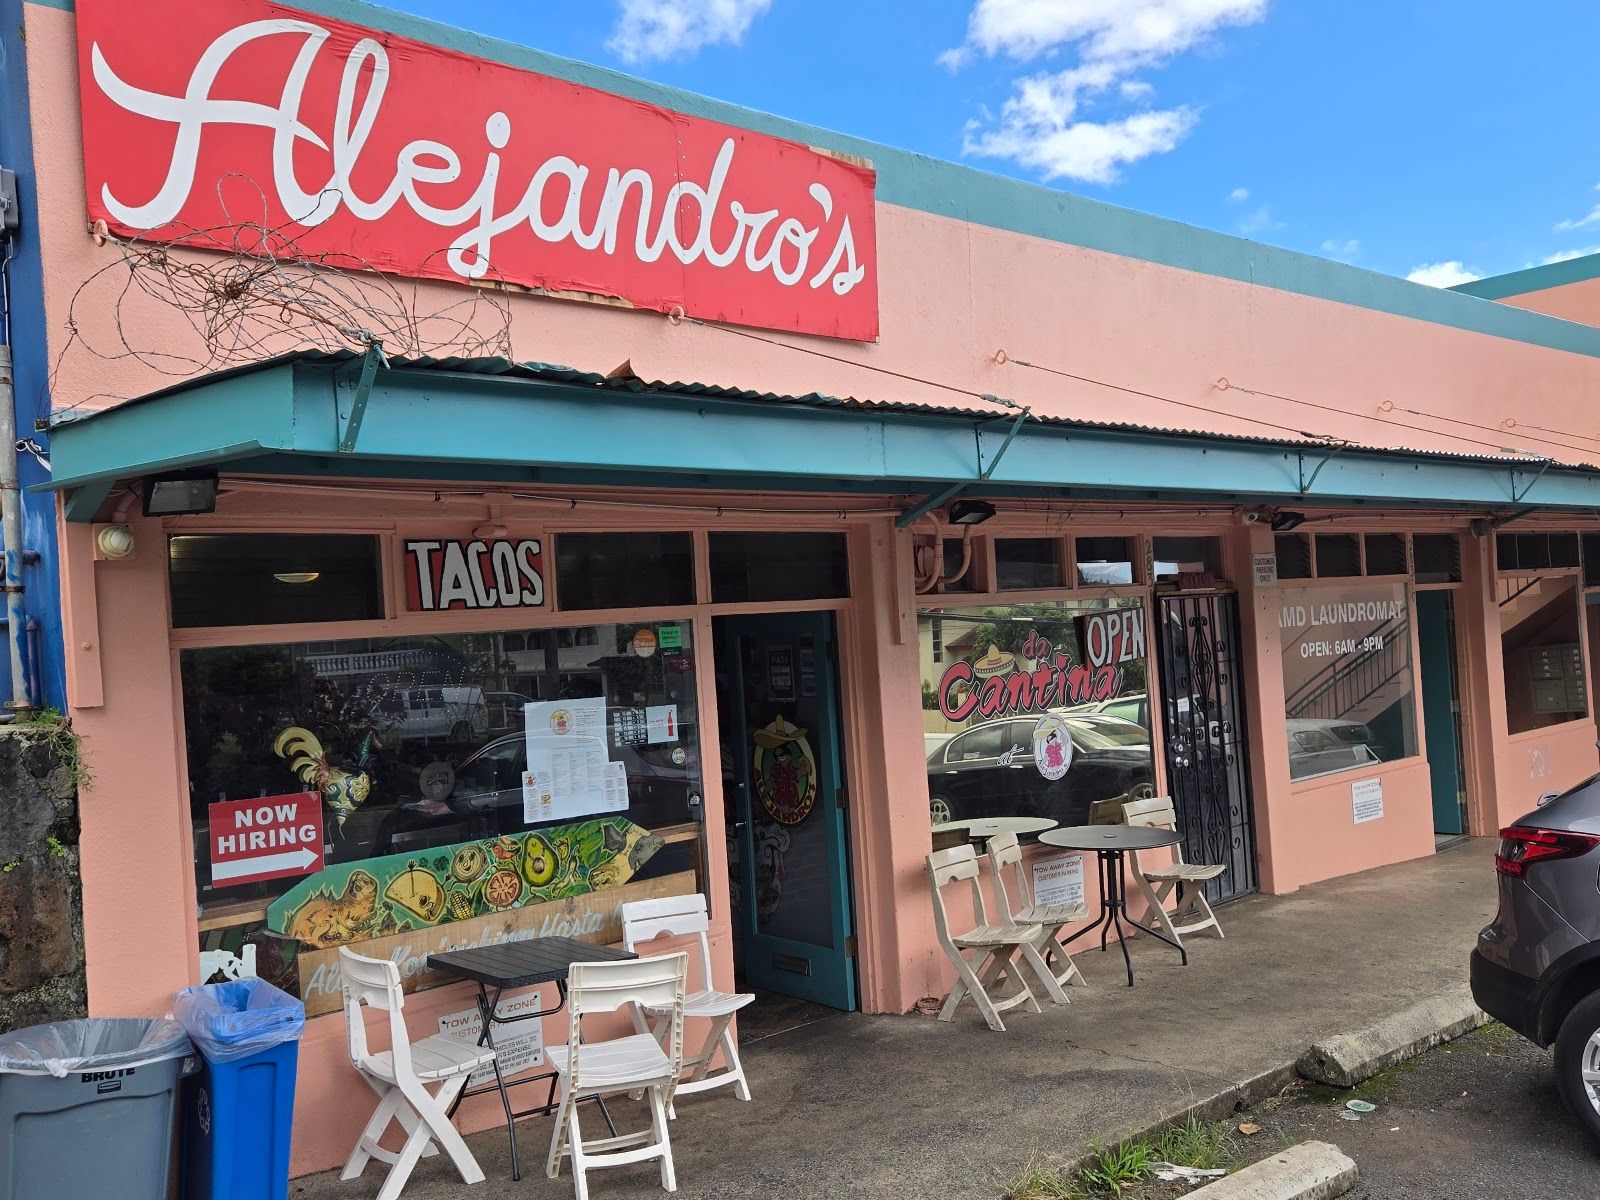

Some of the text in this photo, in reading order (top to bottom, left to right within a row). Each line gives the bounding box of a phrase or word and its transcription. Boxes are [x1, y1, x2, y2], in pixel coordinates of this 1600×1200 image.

[92, 18, 865, 295] Alejandro's
[407, 540, 543, 609] TACOS
[1255, 557, 1275, 565] CUSTOMER
[1260, 574, 1271, 582] ONLY
[1310, 601, 1403, 626] LAUNDROMAT
[1022, 629, 1052, 660] da
[1087, 609, 1145, 668] OPEN
[1300, 640, 1332, 658] OPEN:
[1334, 638, 1356, 655] 6AM
[1363, 635, 1384, 652] 9PM
[938, 652, 1124, 722] Cantina
[234, 803, 298, 829] NOW
[217, 824, 317, 855] HIRING
[1036, 866, 1048, 874] TOW
[1050, 863, 1065, 871] AWAY
[445, 1016, 469, 1030] TOW
[507, 998, 536, 1013] ZONE
[81, 1067, 136, 1083] BRUTE
